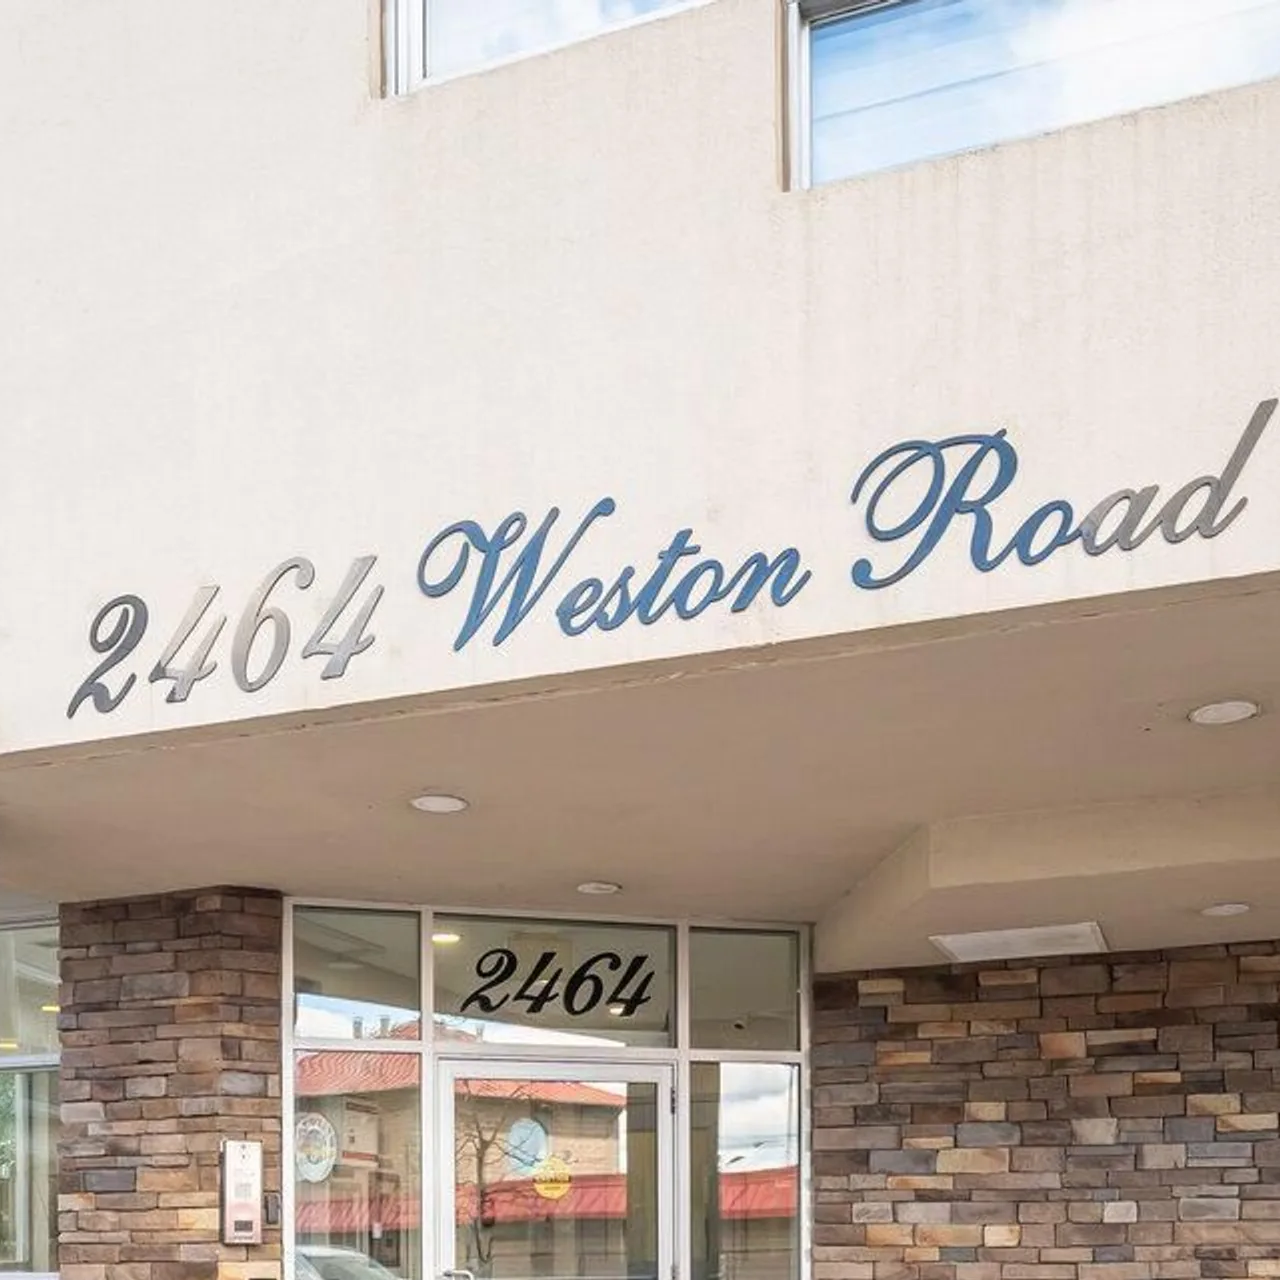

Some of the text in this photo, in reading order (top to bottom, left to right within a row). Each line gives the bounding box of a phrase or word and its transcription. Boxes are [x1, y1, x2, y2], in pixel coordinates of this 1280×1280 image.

[67, 398, 1280, 719] 2464 Weston Road
[460, 948, 656, 1017] 2464
